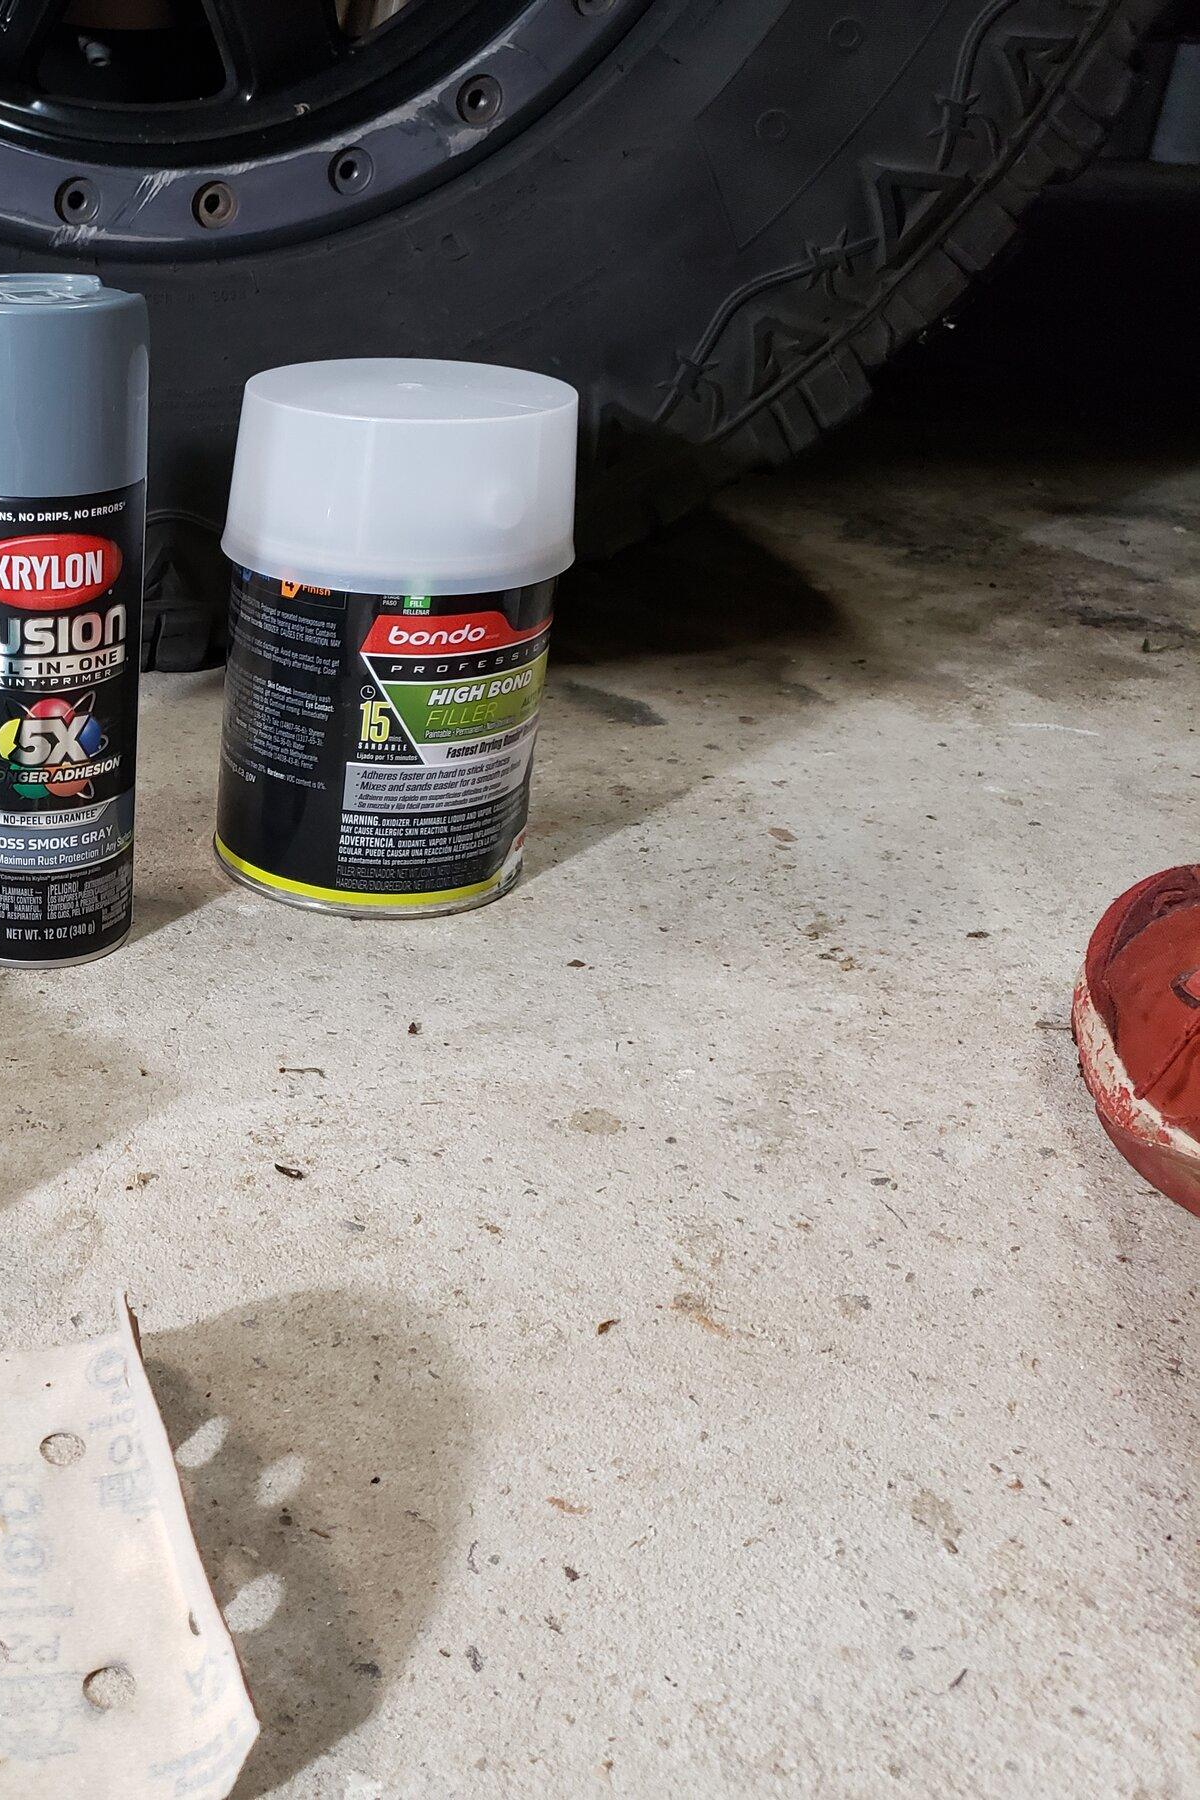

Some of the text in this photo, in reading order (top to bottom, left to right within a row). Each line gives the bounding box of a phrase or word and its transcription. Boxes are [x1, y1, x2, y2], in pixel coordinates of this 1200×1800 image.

[18, 512, 35, 522] NO
[37, 511, 72, 522] DRIPS,
[74, 509, 89, 519] NO
[409, 600, 424, 608] FILL
[387, 623, 486, 646] bondo
[427, 669, 533, 707] HIGH BOND
[425, 701, 498, 727] FILLER
[360, 700, 392, 743] 15
[15, 714, 89, 767] 5X
[357, 742, 408, 752] SANDABLE
[446, 738, 502, 759] Fastest Drying
[356, 752, 374, 761] Lijado
[374, 754, 385, 762] por
[386, 753, 394, 761] 15
[52, 757, 121, 783] ADHESION
[360, 770, 398, 781] Adheres
[399, 771, 425, 781] faster
[425, 772, 438, 780] on
[438, 768, 457, 780] hard
[457, 768, 466, 777] to
[466, 763, 485, 775] stick
[360, 781, 387, 791] Mixes
[387, 782, 405, 792] and
[405, 782, 433, 792] sands
[432, 780, 459, 791] easier
[459, 778, 470, 788] for
[3, 814, 44, 826] NO-PEEL
[341, 811, 477, 827] WARNING. OXIDIZER. FLAMMABLE AND
[28, 834, 78, 851] SMOKE
[81, 824, 114, 845] GRAY
[340, 825, 448, 836] MAY CAUSE ALLERGIC SKIN REACTION.
[339, 834, 396, 848] ADVERTENCIA.
[397, 839, 428, 848] OXIDANTE.
[428, 837, 448, 847] VAPOR
[37, 854, 58, 866] Rust
[59, 849, 99, 864] Protection
[337, 855, 348, 863] Lea
[338, 846, 364, 856] OCULAR.
[364, 848, 386, 857] PUEDE
[386, 849, 410, 858] CAUSAR
[410, 849, 423, 857] UNA
[1, 885, 34, 897] FLAMMABLE
[16, 896, 43, 905] CONTENTS
[6, 911, 43, 921] RESPIRATORY
[5, 920, 96, 941] NET WT. 12 OZ (340 g)
